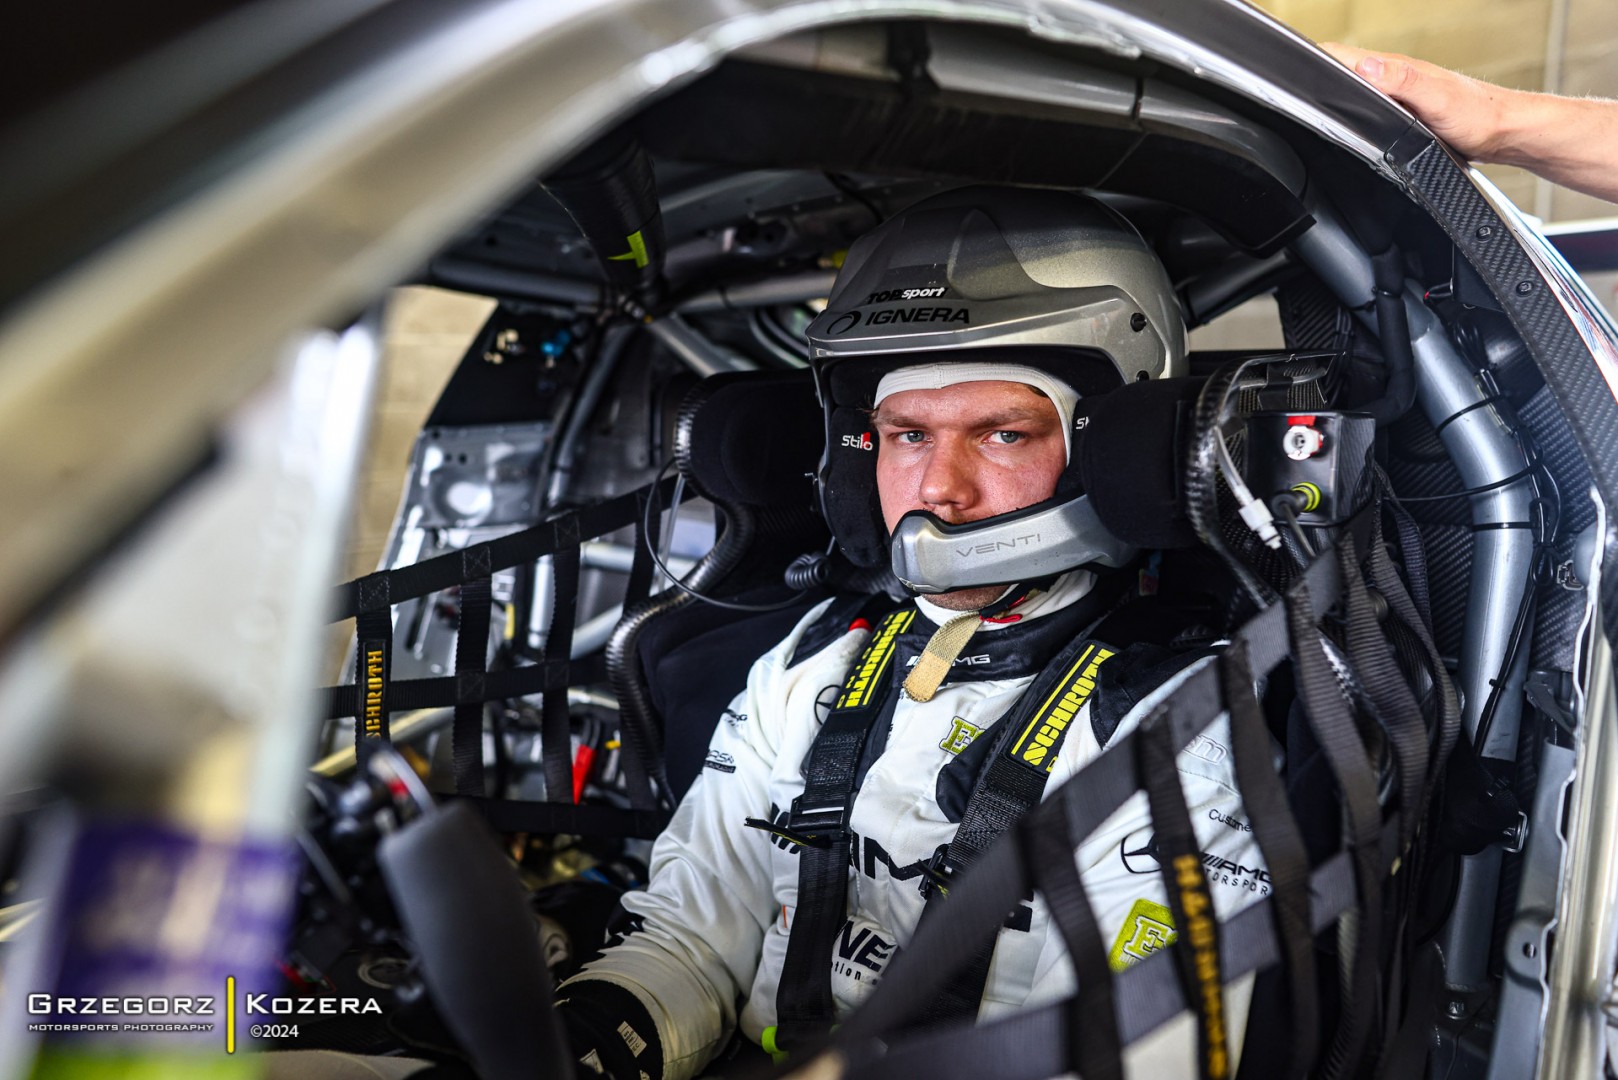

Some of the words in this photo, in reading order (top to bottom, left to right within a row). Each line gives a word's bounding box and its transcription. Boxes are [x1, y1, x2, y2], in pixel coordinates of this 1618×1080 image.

[865, 307, 970, 327] IGNERA
[841, 431, 873, 451] Stilo
[955, 533, 1041, 557] VENTI
